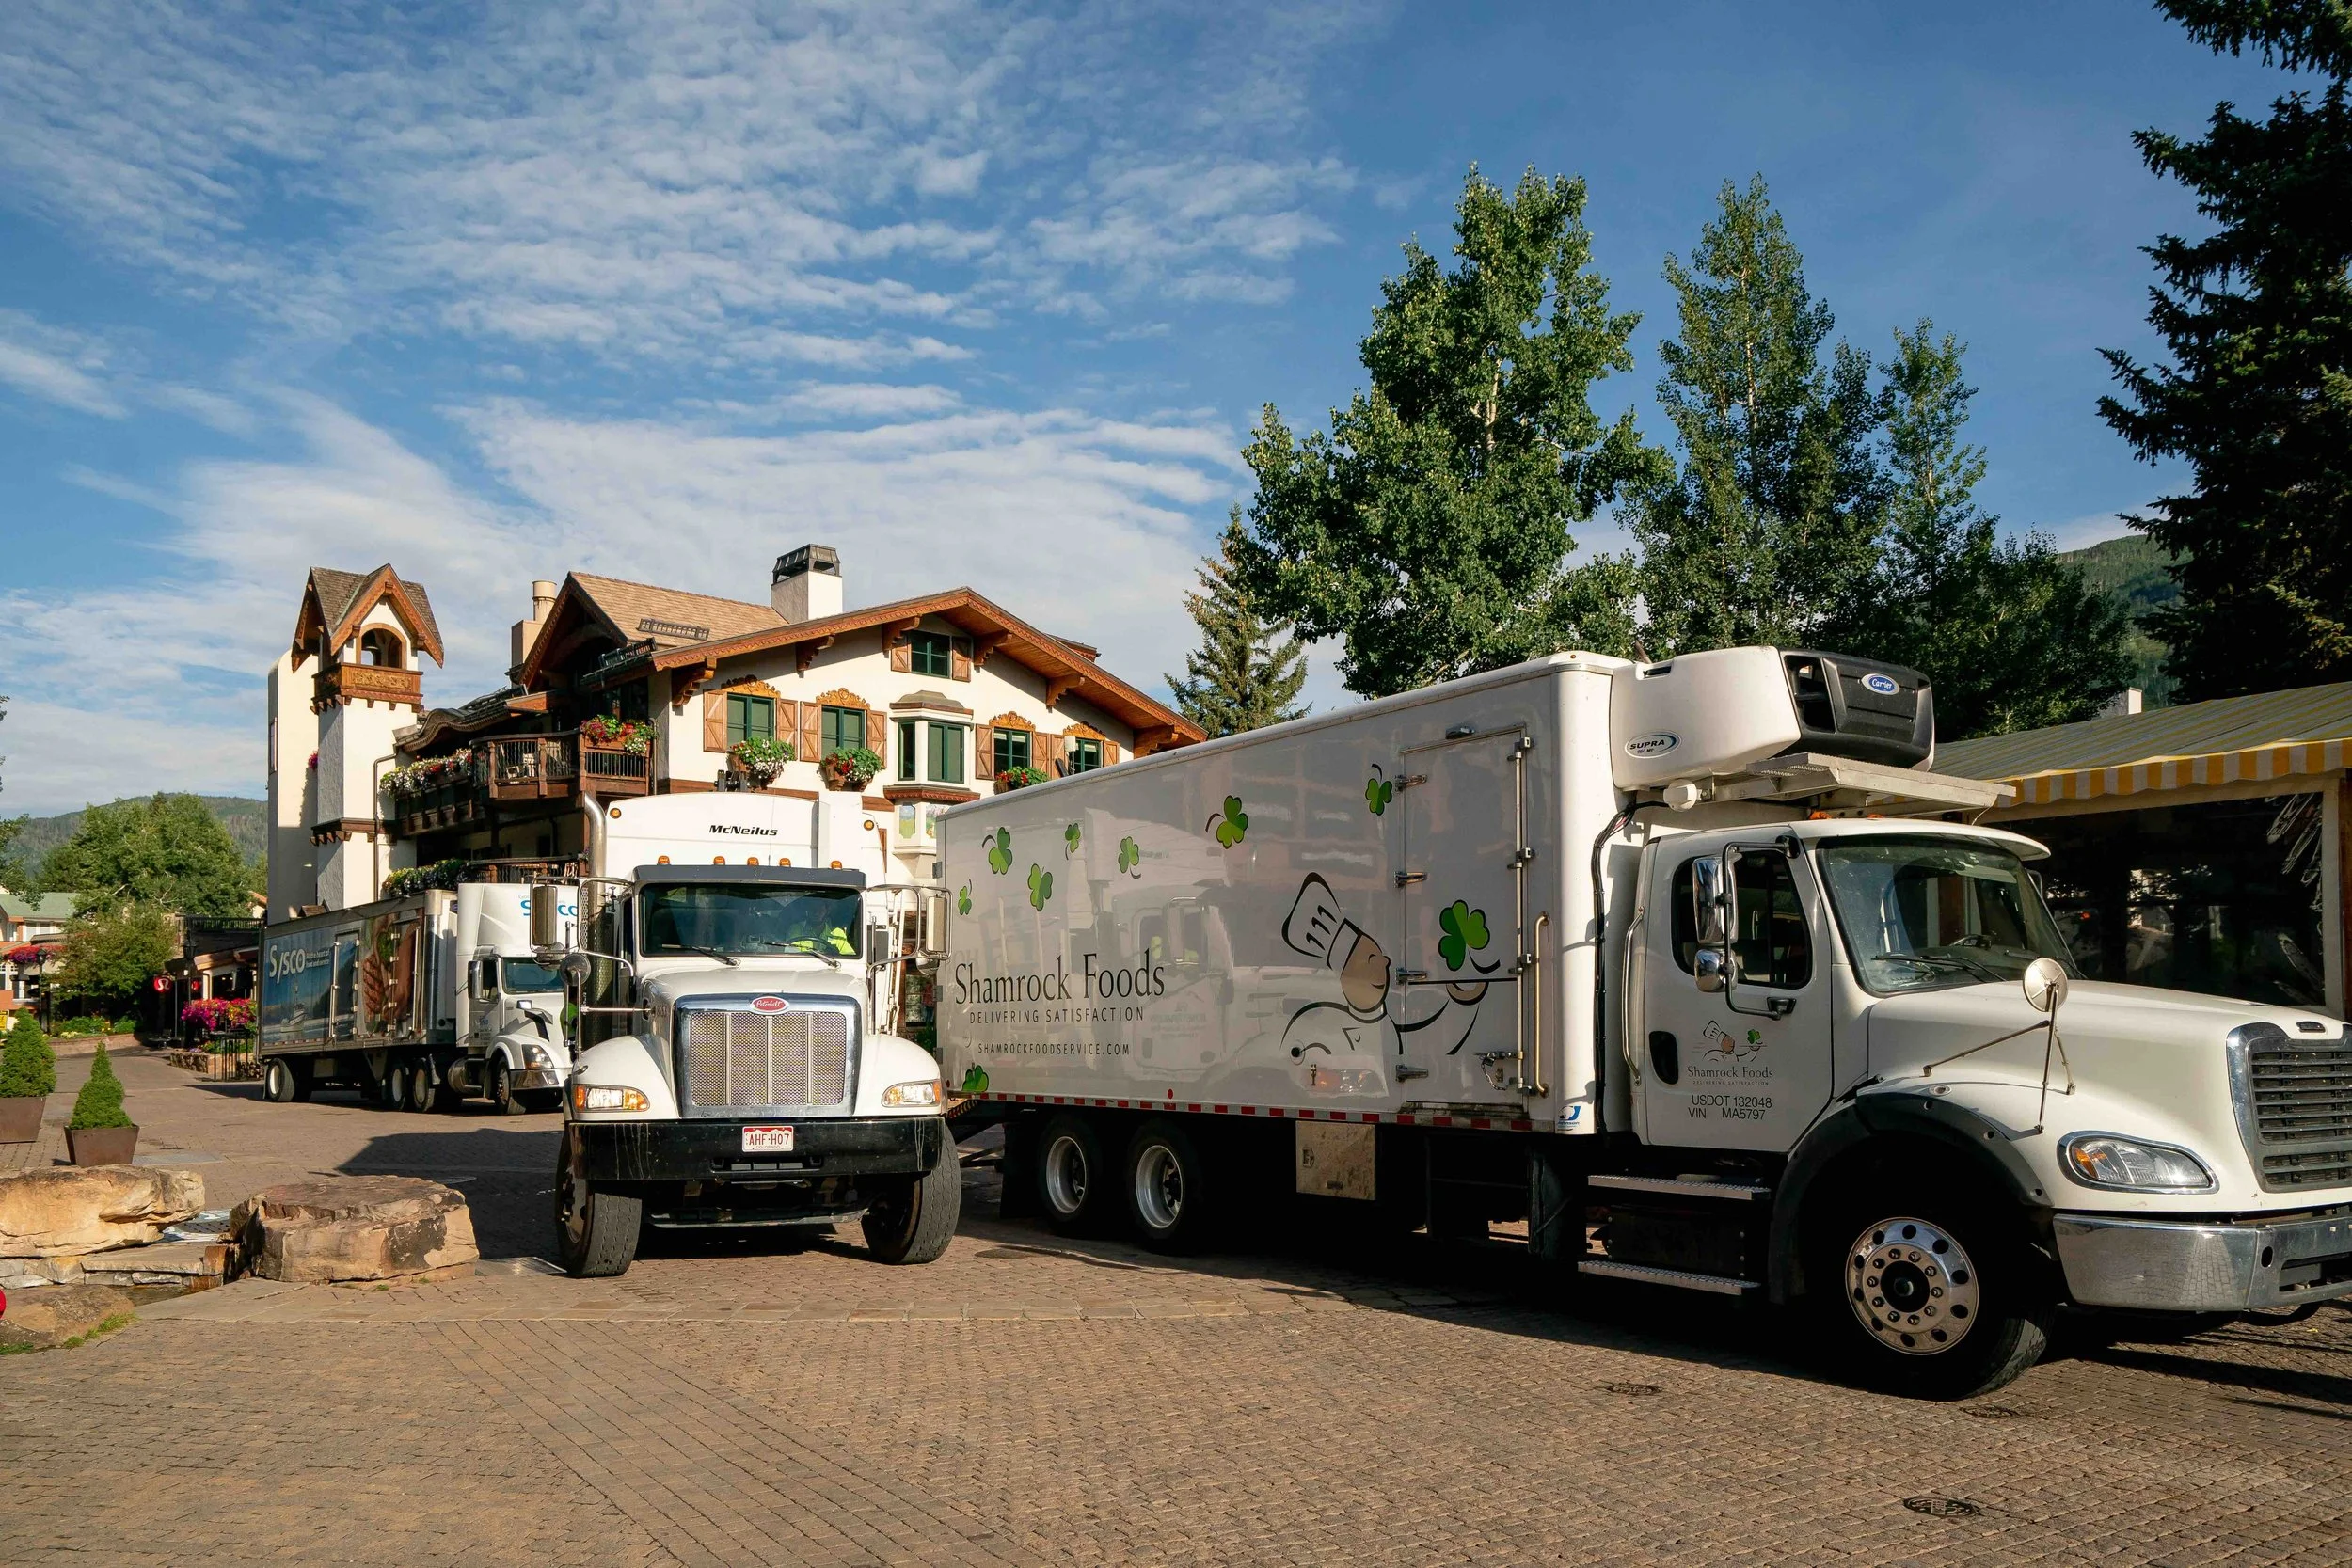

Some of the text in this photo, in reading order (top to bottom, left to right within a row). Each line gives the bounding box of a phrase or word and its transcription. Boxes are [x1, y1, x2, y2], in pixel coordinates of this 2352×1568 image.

[1871, 677, 1893, 689] Carrier
[1629, 738, 1665, 750] SUPRA
[708, 823, 779, 837] McNeilus
[520, 899, 578, 917] Sco
[954, 954, 1072, 1005] Shamrock
[1082, 947, 1165, 999] Foods
[756, 999, 783, 1008] Peterbilt
[970, 1009, 1039, 1024] DELIVERING
[1045, 1006, 1144, 1022] SATISFACTION
[977, 1043, 1130, 1055] SHAMROCKFOODSERVICE.COM
[1687, 1065, 1773, 1078] Shamrock Foods
[1692, 1094, 1772, 1109] USDOT 132048
[1688, 1107, 1766, 1120] VIN MA5797
